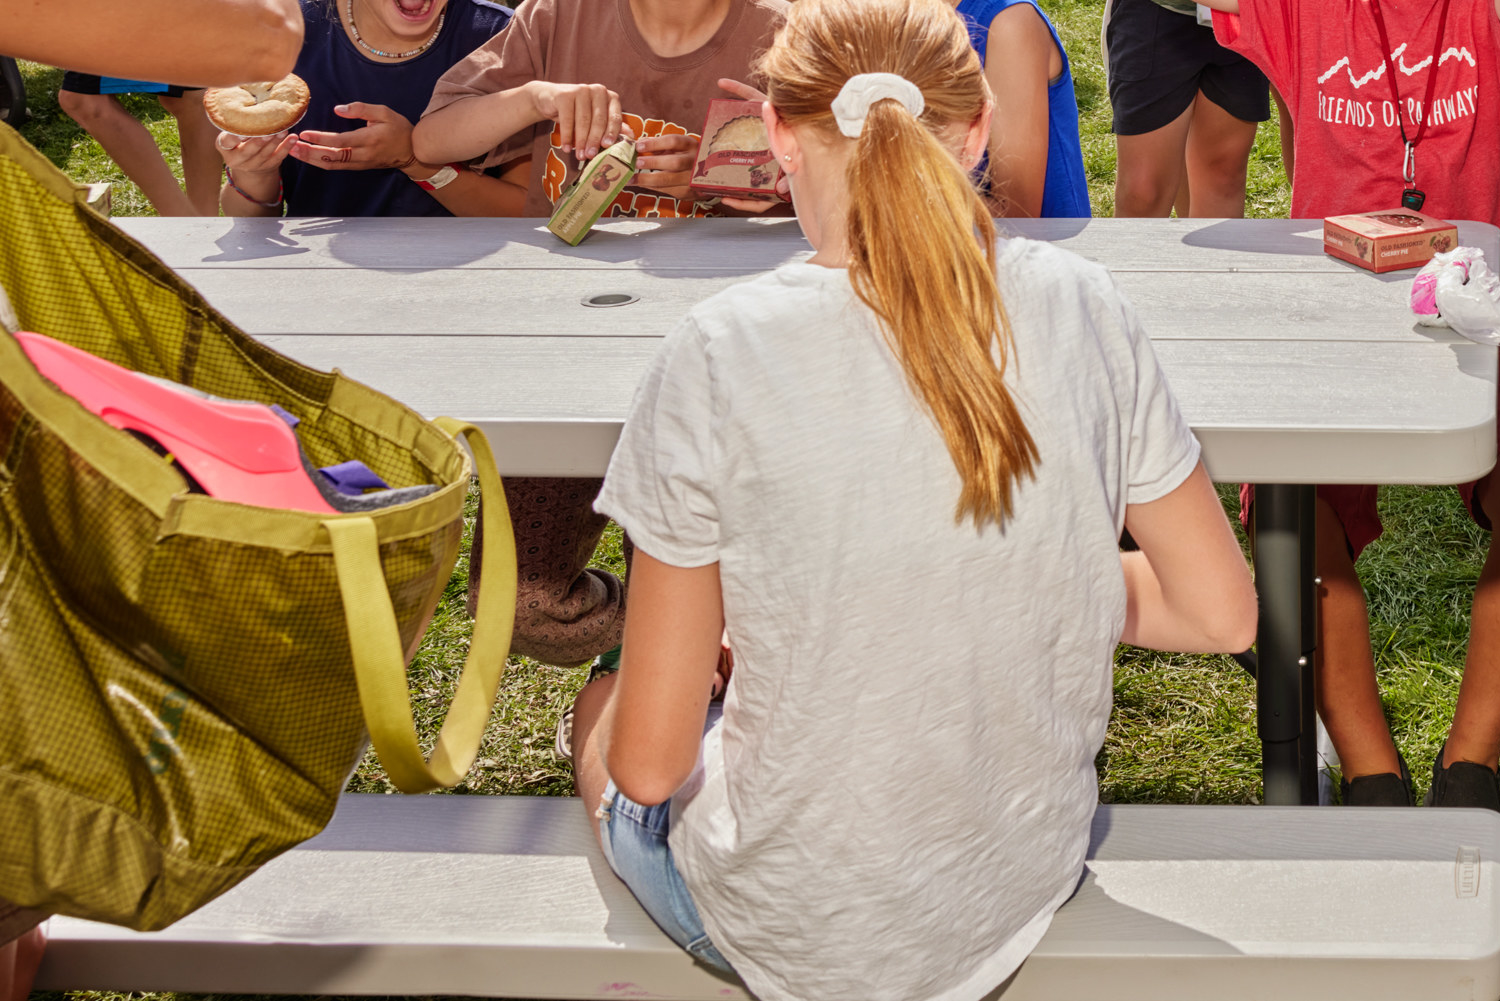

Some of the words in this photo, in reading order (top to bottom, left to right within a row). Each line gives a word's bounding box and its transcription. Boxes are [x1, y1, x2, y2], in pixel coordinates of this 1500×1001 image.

[1318, 90, 1375, 128] FRIENDS
[718, 151, 731, 159] OLD
[557, 218, 568, 231] OLD
[566, 191, 590, 219] FASHIONED
[1380, 244, 1393, 252] OLD
[1393, 240, 1424, 250] FASHIONED
[1380, 248, 1400, 258] CHERRY
[1400, 248, 1409, 256] PIE
